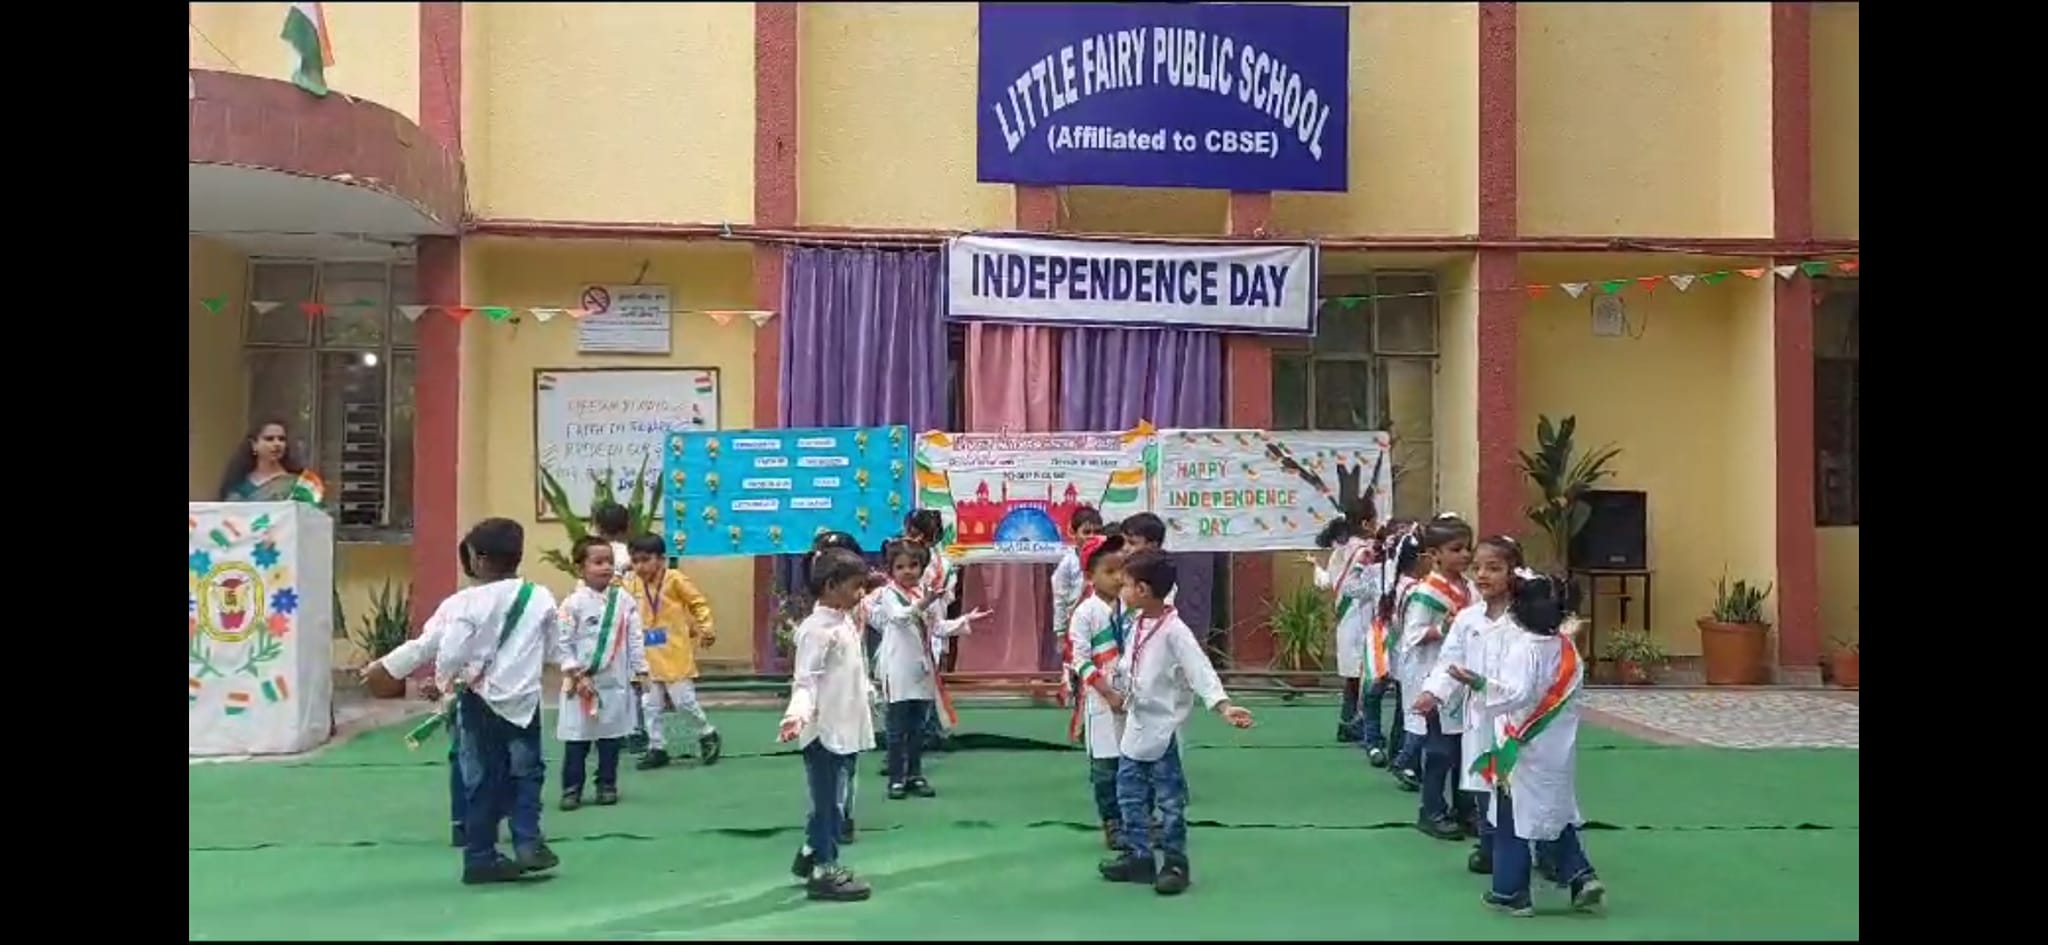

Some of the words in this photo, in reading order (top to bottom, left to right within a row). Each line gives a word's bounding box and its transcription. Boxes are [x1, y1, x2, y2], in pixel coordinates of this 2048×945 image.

[993, 44, 1079, 154] LITTLE
[1081, 27, 1147, 96] FAIRY
[1153, 26, 1234, 96] PUBLIC
[1238, 44, 1331, 161] SCHOOL
[1047, 125, 1166, 153] (Affiliated
[1173, 129, 1197, 152] to
[1204, 129, 1279, 158] CBSE)
[972, 253, 1218, 306] INDEPENDENCE
[1229, 263, 1289, 307] DAY
[1176, 460, 1229, 480] HAPPY
[1169, 488, 1297, 508] INDEPENDENCE
[1200, 517, 1232, 537] DAY
